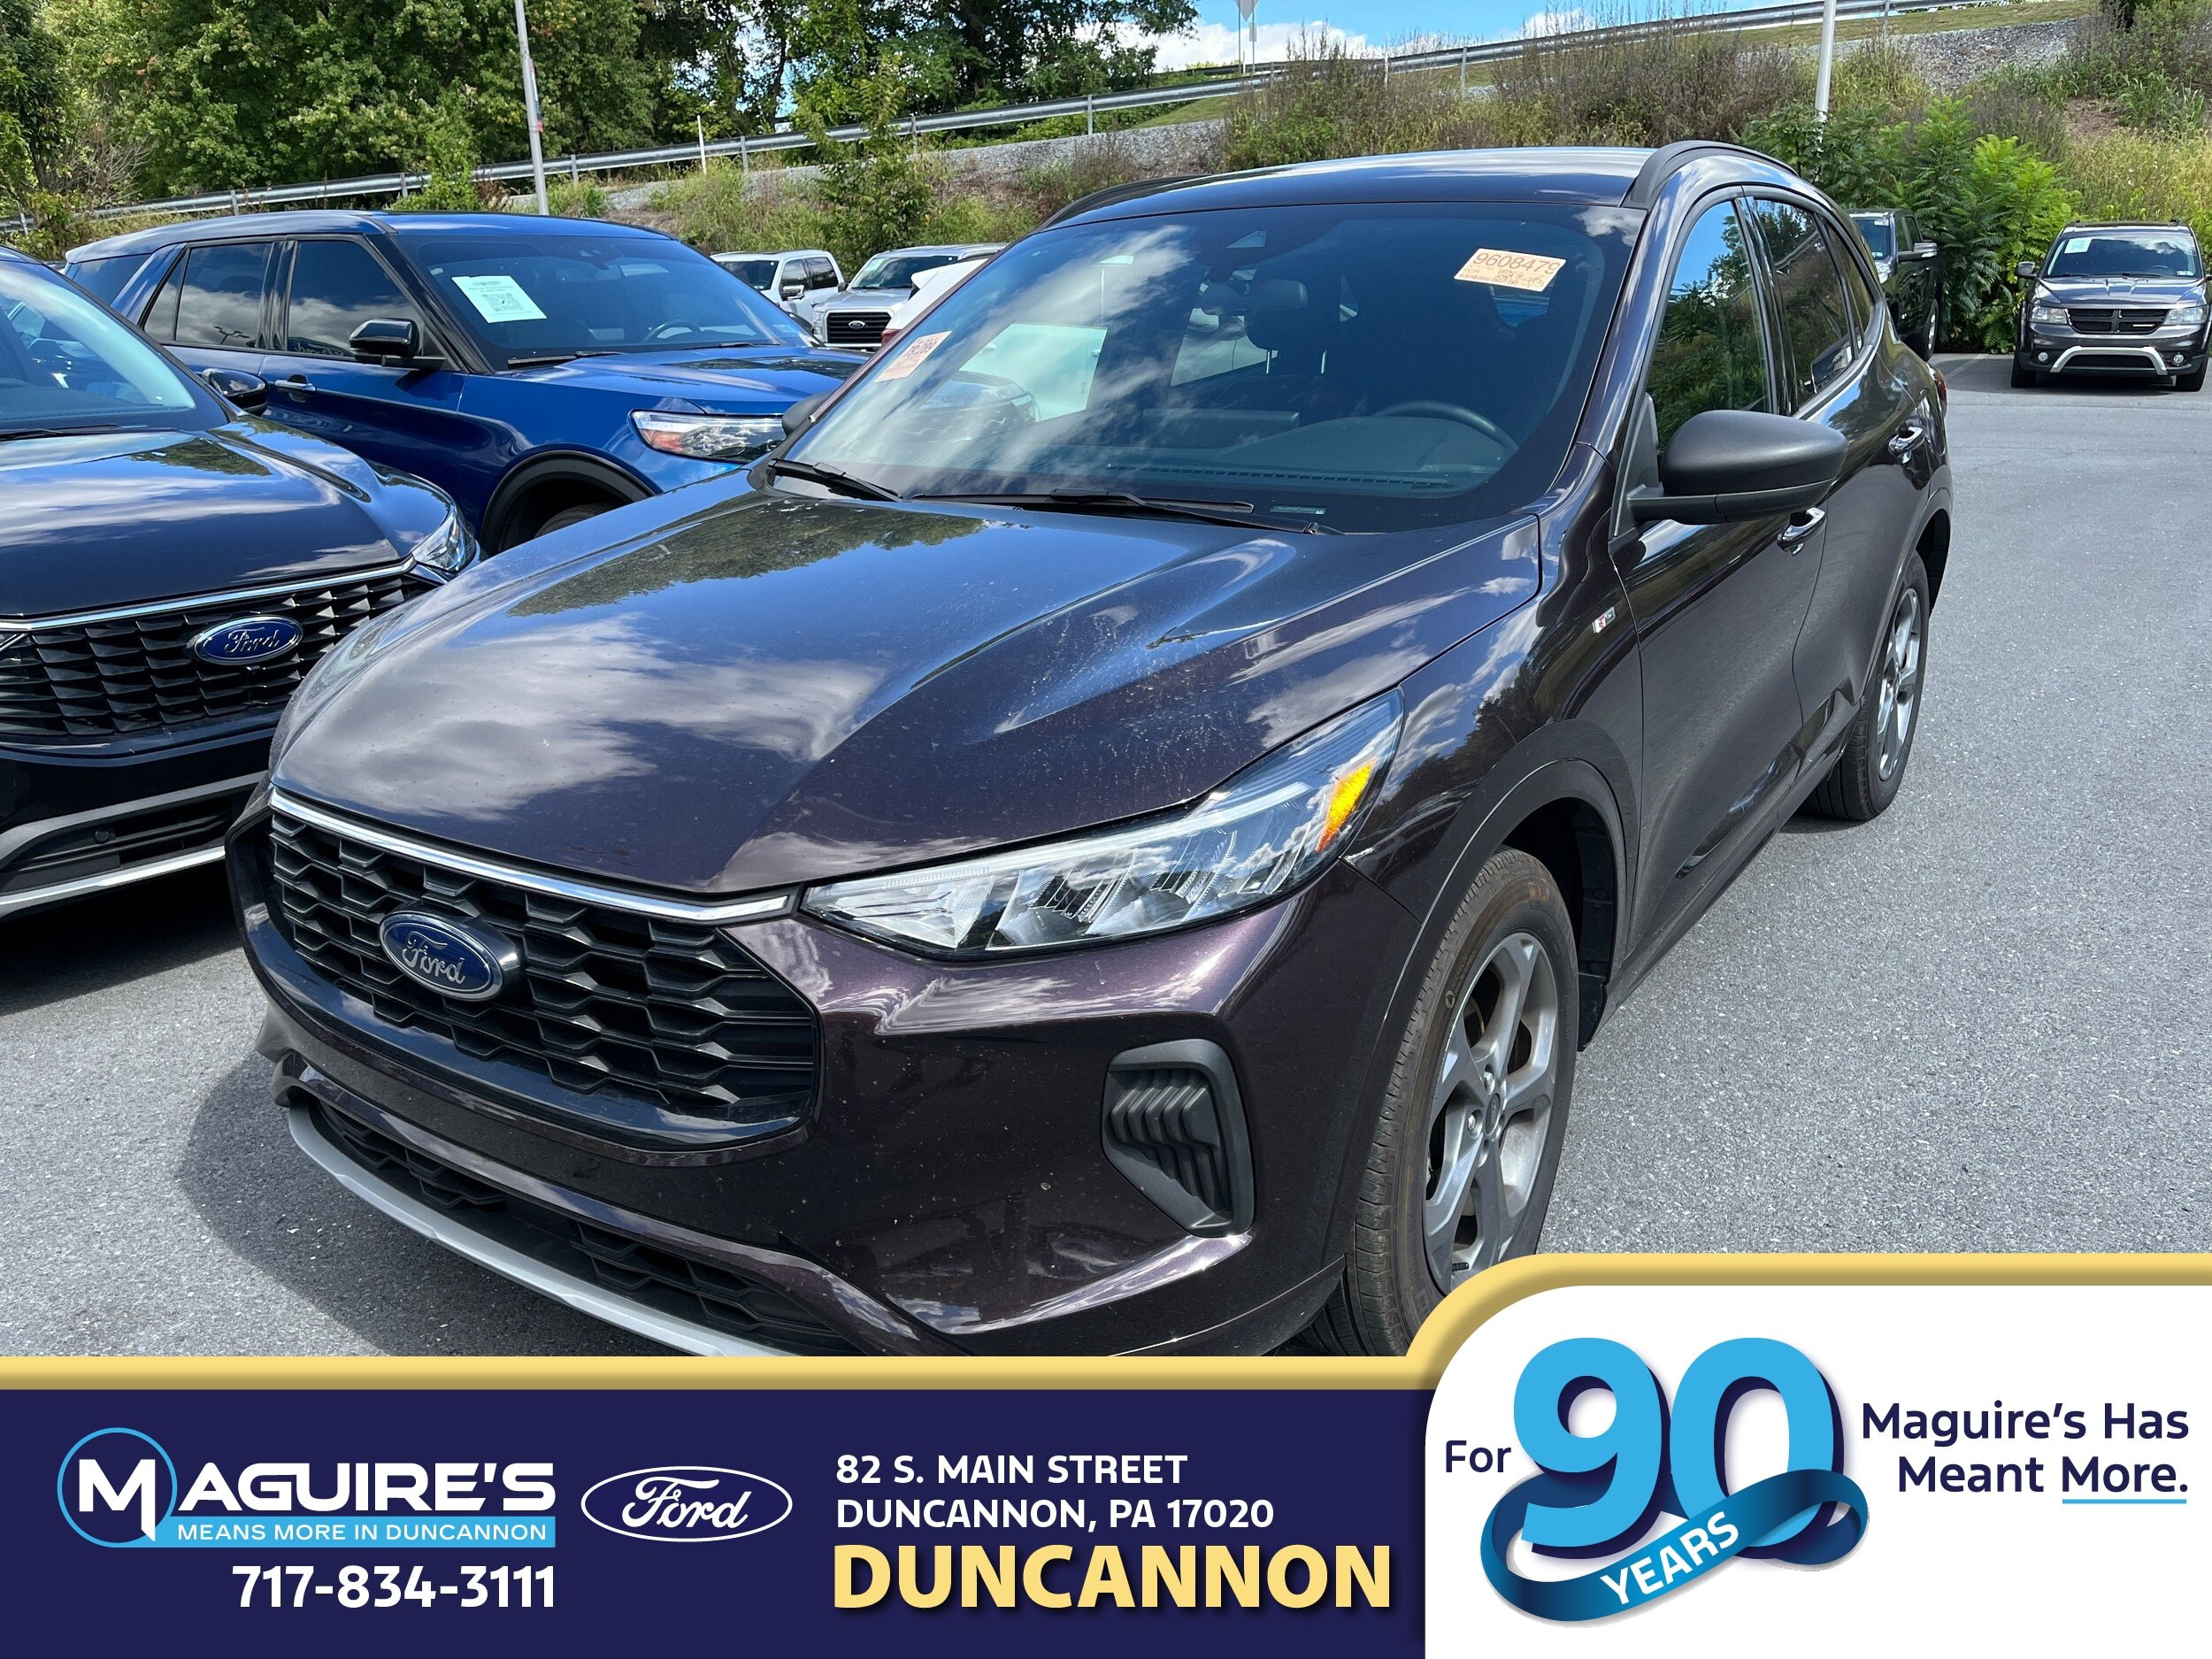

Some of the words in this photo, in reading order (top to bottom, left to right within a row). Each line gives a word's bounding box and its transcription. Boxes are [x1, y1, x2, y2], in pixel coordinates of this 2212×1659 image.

[1473, 252, 1561, 274] 9608479
[224, 626, 280, 654] Ford
[402, 931, 466, 984] Ford
